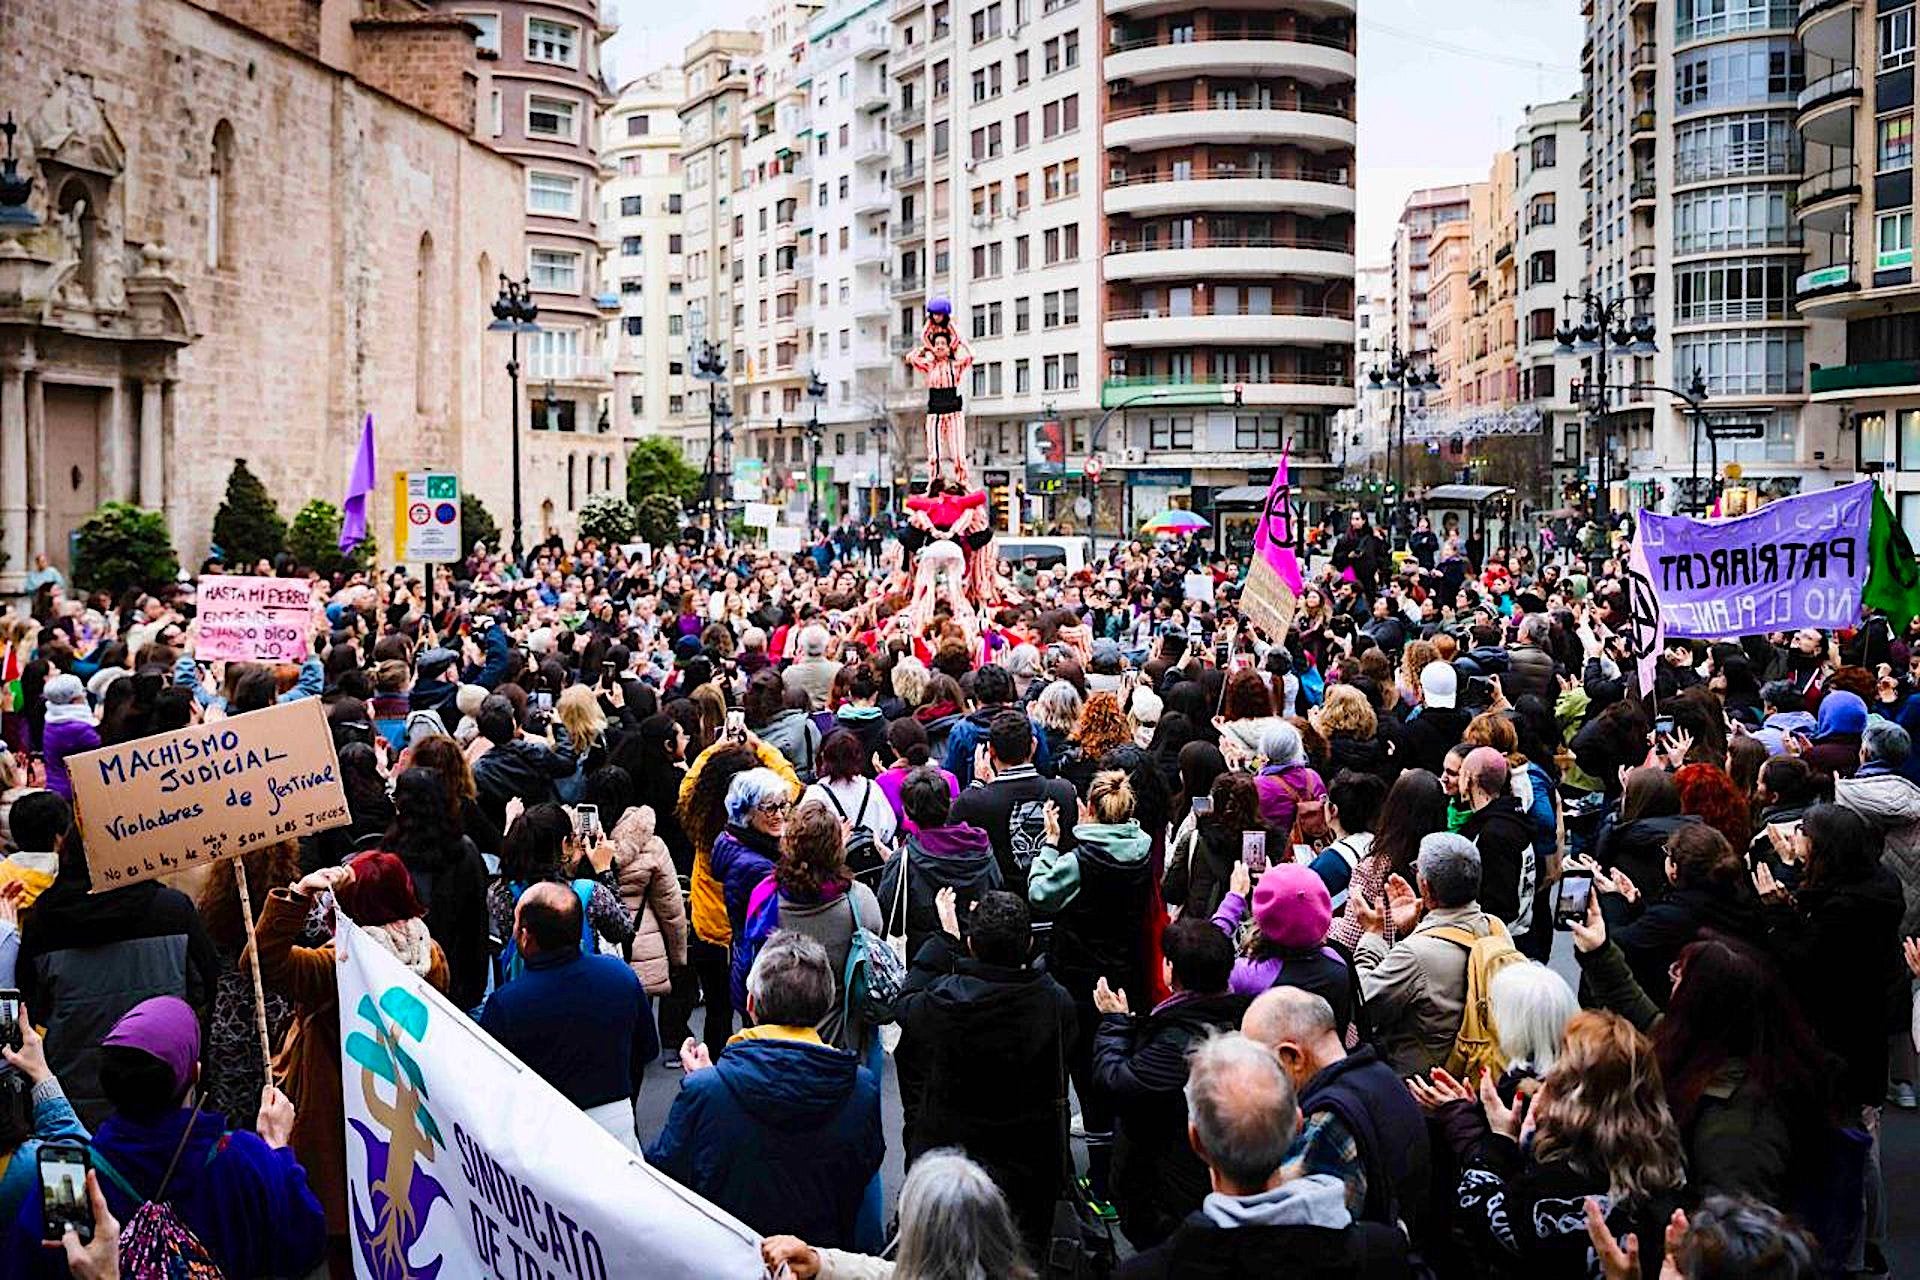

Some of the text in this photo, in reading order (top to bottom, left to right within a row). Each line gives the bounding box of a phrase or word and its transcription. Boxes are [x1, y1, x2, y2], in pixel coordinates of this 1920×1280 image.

[206, 587, 246, 601] HASTA
[265, 626, 297, 641] DICO
[99, 730, 238, 785] MACHISMO
[160, 747, 288, 793] JUDICIAL
[105, 803, 204, 841] Violadores
[226, 788, 252, 806] de
[104, 868, 121, 881] No
[127, 865, 138, 876] es
[453, 1122, 609, 1280] SINDICATO
[469, 1199, 506, 1280] DE
